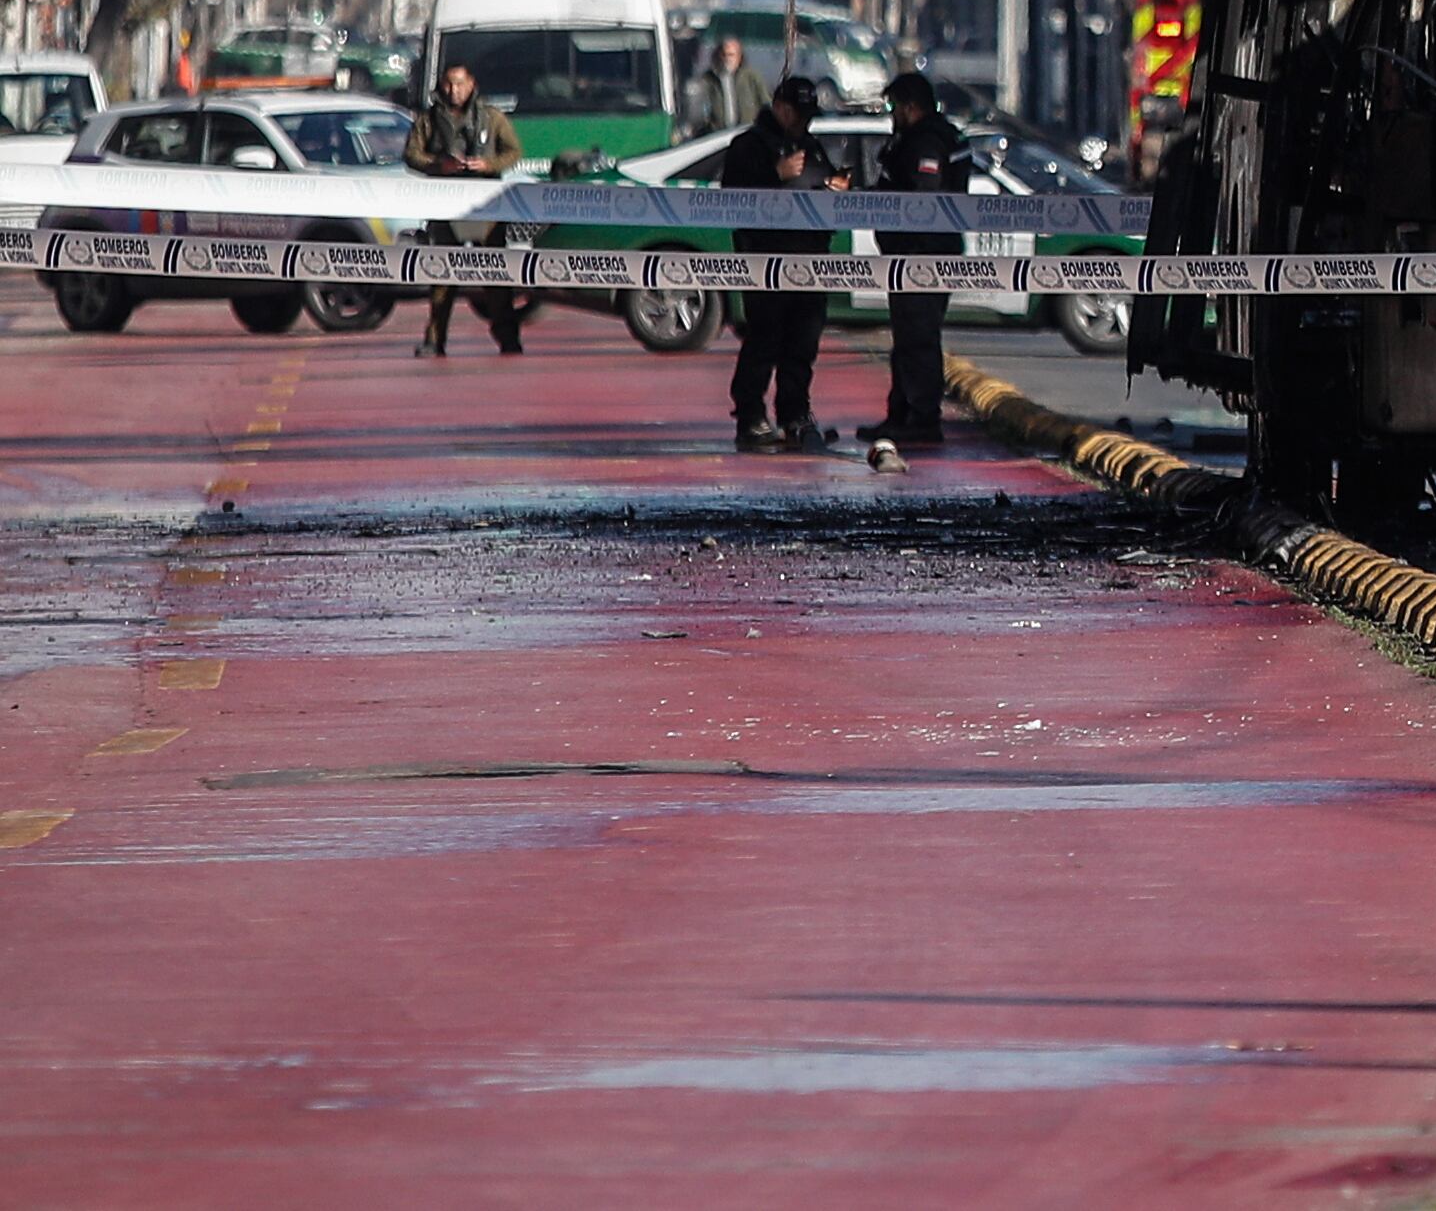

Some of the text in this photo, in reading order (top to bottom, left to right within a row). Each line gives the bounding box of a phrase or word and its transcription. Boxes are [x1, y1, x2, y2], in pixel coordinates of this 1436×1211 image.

[94, 238, 150, 255] BOMBEROS
[211, 243, 267, 261] BOMBEROS
[329, 249, 386, 265] BOMBEROS
[450, 252, 506, 269] BOMBEROS
[569, 256, 627, 272] BOMBEROS
[690, 259, 749, 274] BOMBEROS
[812, 260, 872, 276] BOMBEROS
[936, 261, 996, 277] BOMBEROS
[1061, 261, 1121, 277] BOMBEROS
[1186, 261, 1248, 277] BOMBEROS
[1314, 260, 1376, 276] BOMBEROS
